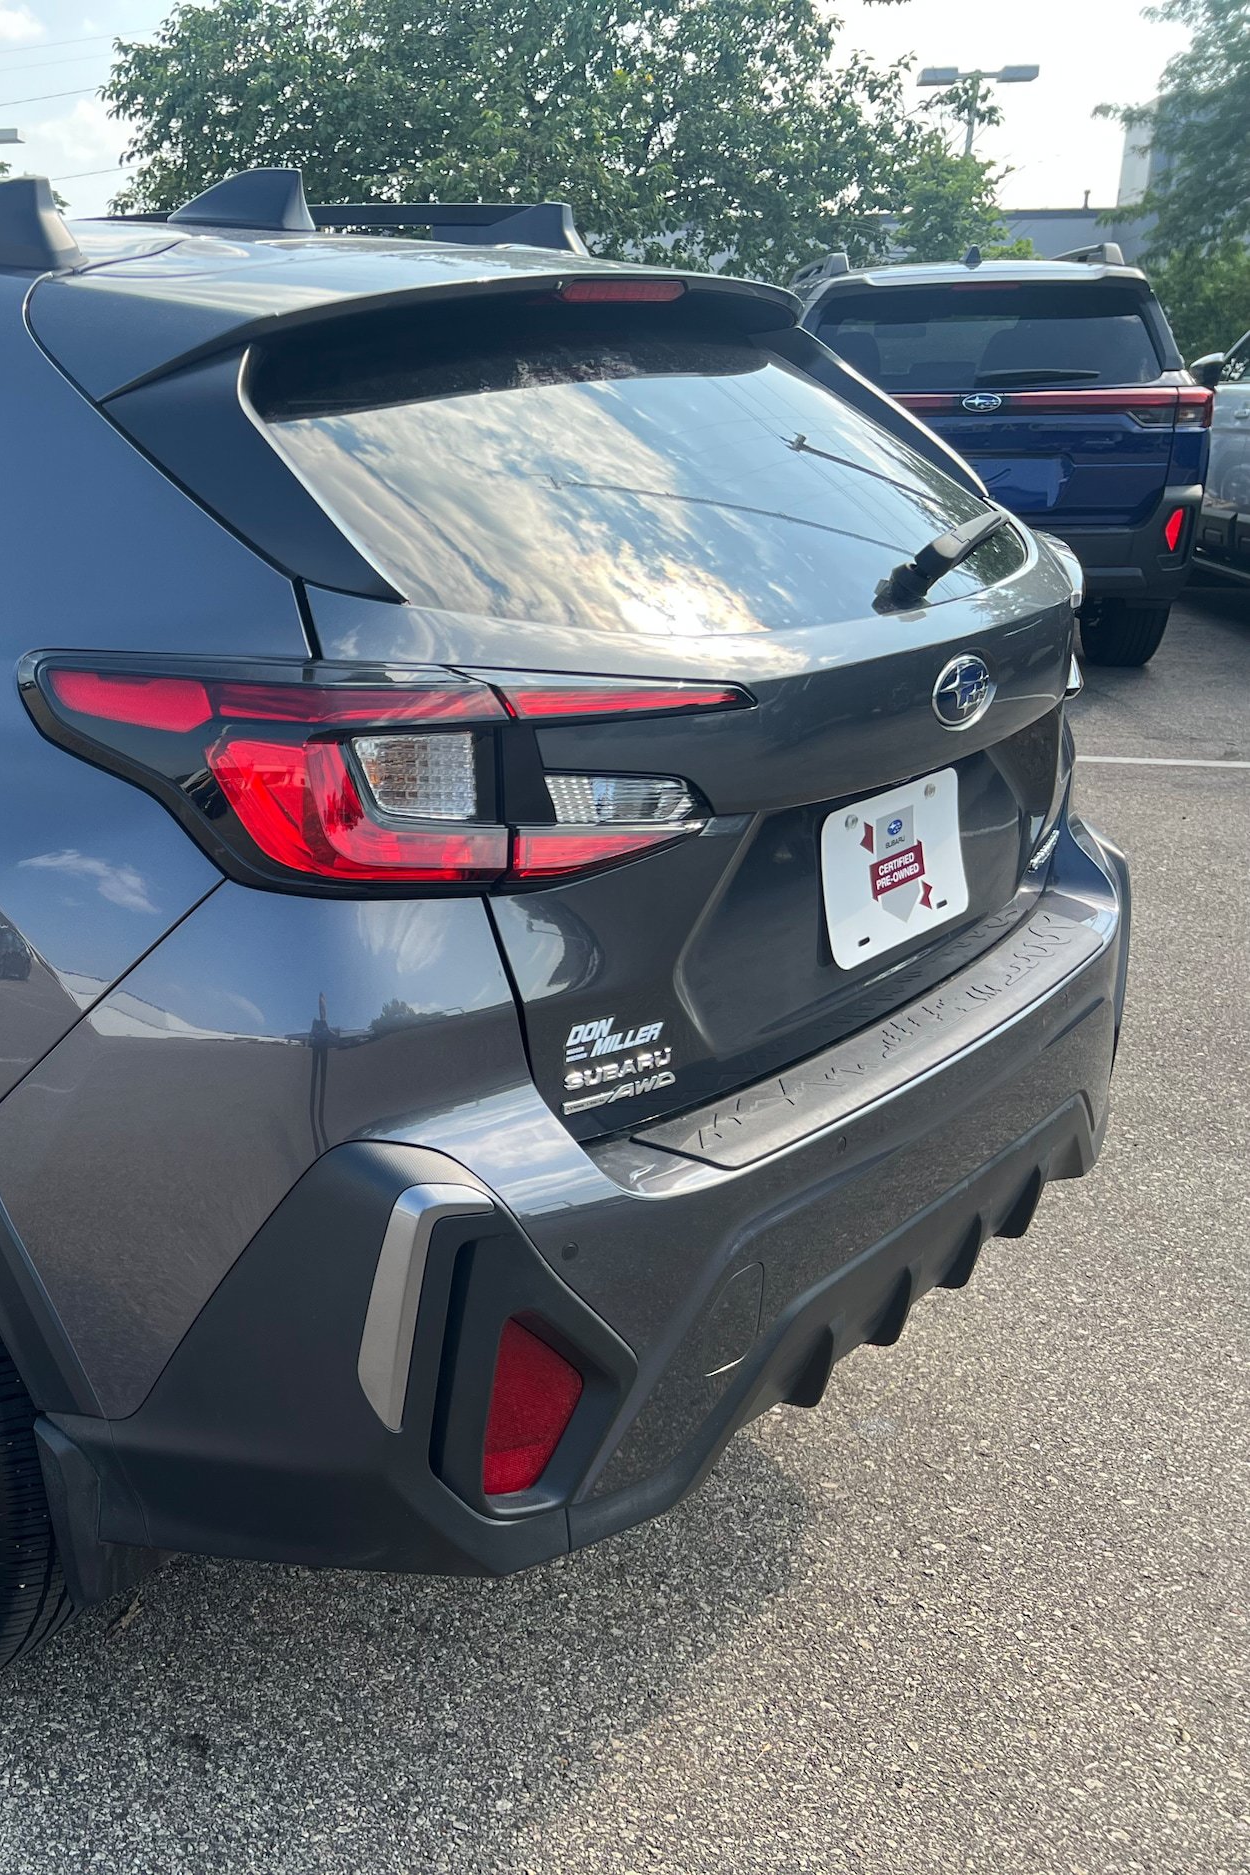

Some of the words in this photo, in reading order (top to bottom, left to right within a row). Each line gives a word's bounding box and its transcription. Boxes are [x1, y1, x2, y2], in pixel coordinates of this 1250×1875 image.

[885, 836, 906, 849] SUBARU
[876, 863, 920, 890] PRE-OWNED
[878, 852, 915, 876] CERTIFIED
[566, 1016, 615, 1047] DON
[589, 1021, 665, 1058] MILLER
[563, 1046, 673, 1091] SUBARU
[607, 1071, 677, 1104] AWD
